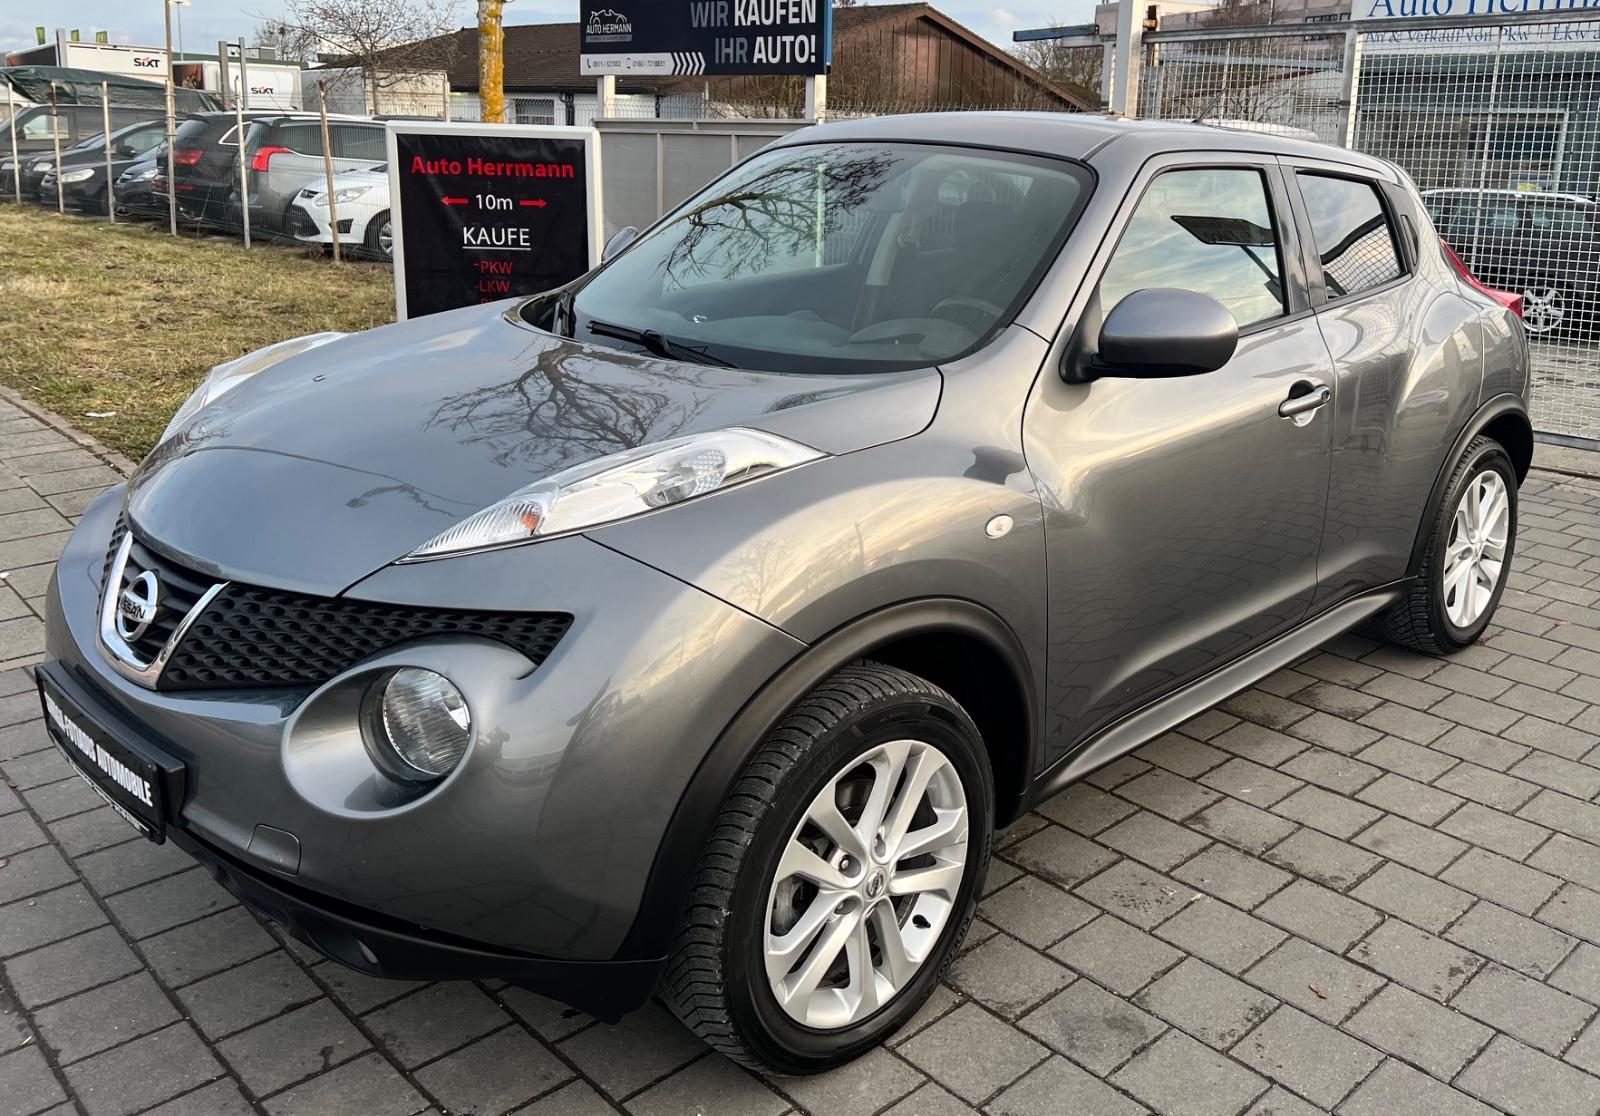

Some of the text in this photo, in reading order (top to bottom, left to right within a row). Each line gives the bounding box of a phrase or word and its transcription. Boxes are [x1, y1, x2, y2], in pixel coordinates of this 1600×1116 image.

[690, 0, 816, 28] WIR KAUFEN
[1367, 0, 1453, 17] Auto
[586, 24, 602, 34] AUTO
[1408, 29, 1461, 43] Verkauf
[1552, 25, 1585, 40] Lkw
[714, 34, 816, 64] IHR AUTO!
[411, 156, 574, 178] Auto Herrmann
[475, 194, 513, 210] 10m
[463, 227, 531, 246] KAUFE
